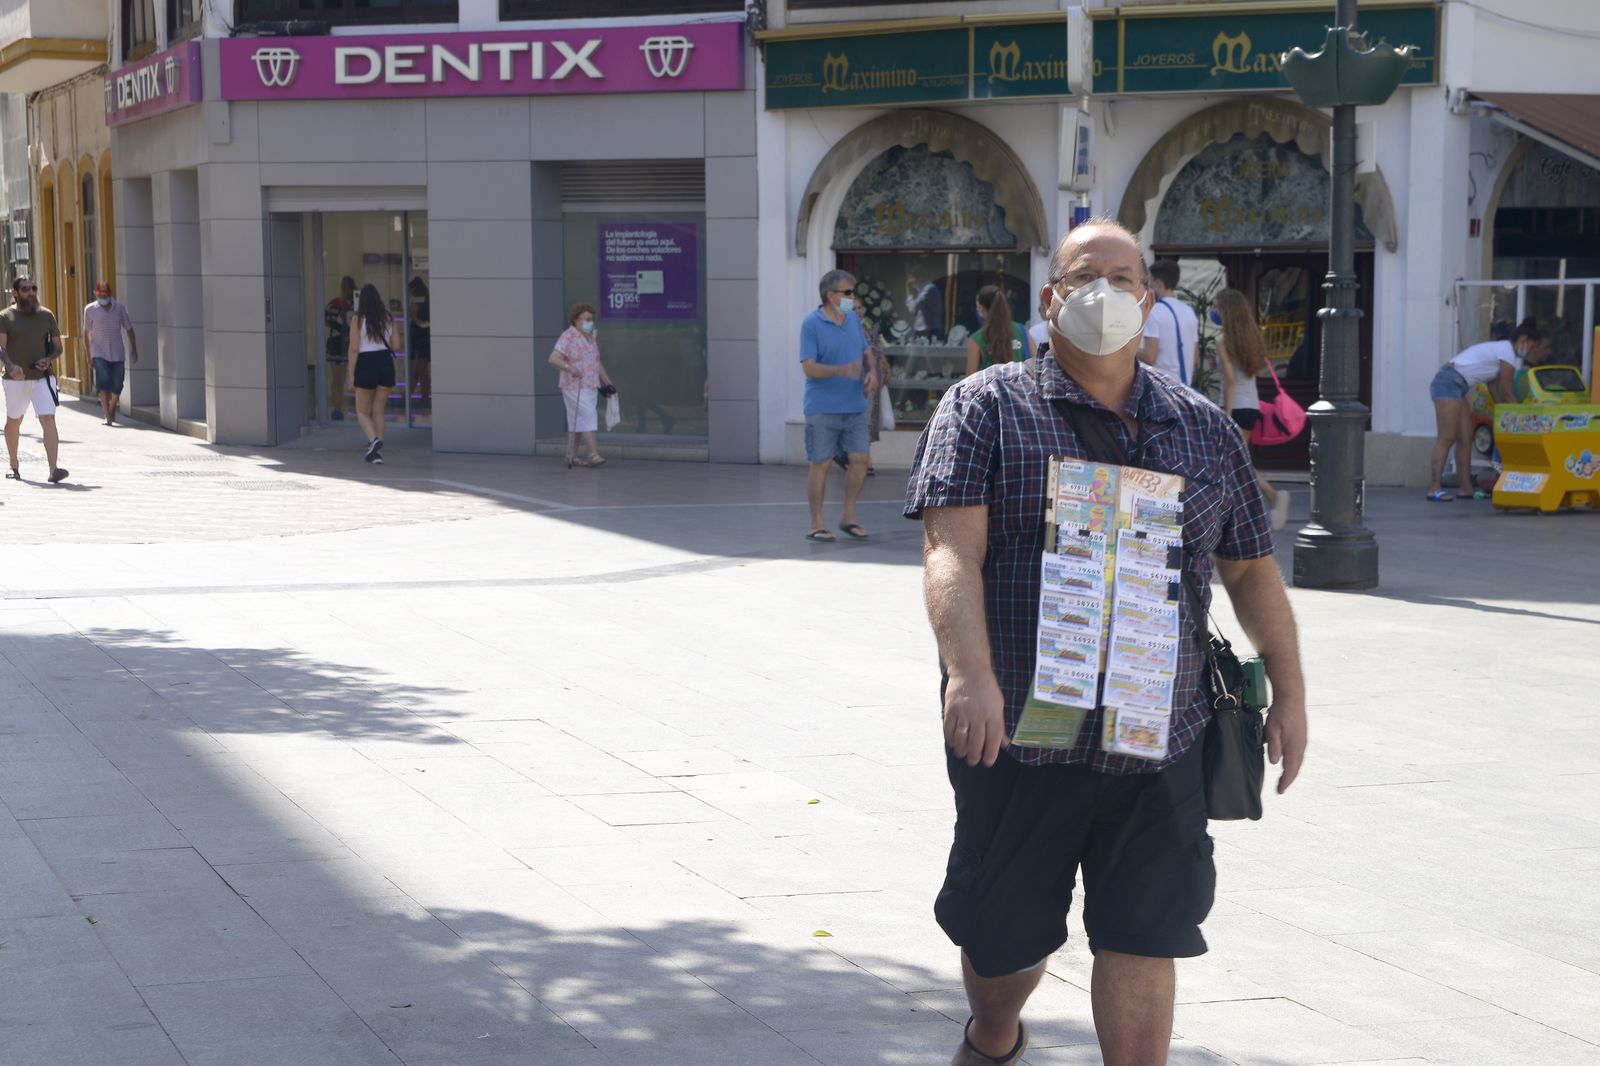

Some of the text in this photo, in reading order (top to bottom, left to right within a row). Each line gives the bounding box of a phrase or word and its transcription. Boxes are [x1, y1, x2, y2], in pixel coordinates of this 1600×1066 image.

[334, 39, 605, 85] DENTIX
[822, 51, 918, 93] Maximino
[988, 39, 1103, 84] Maximo
[1132, 53, 1196, 66] JOYEROS
[117, 61, 161, 109] DENTIX
